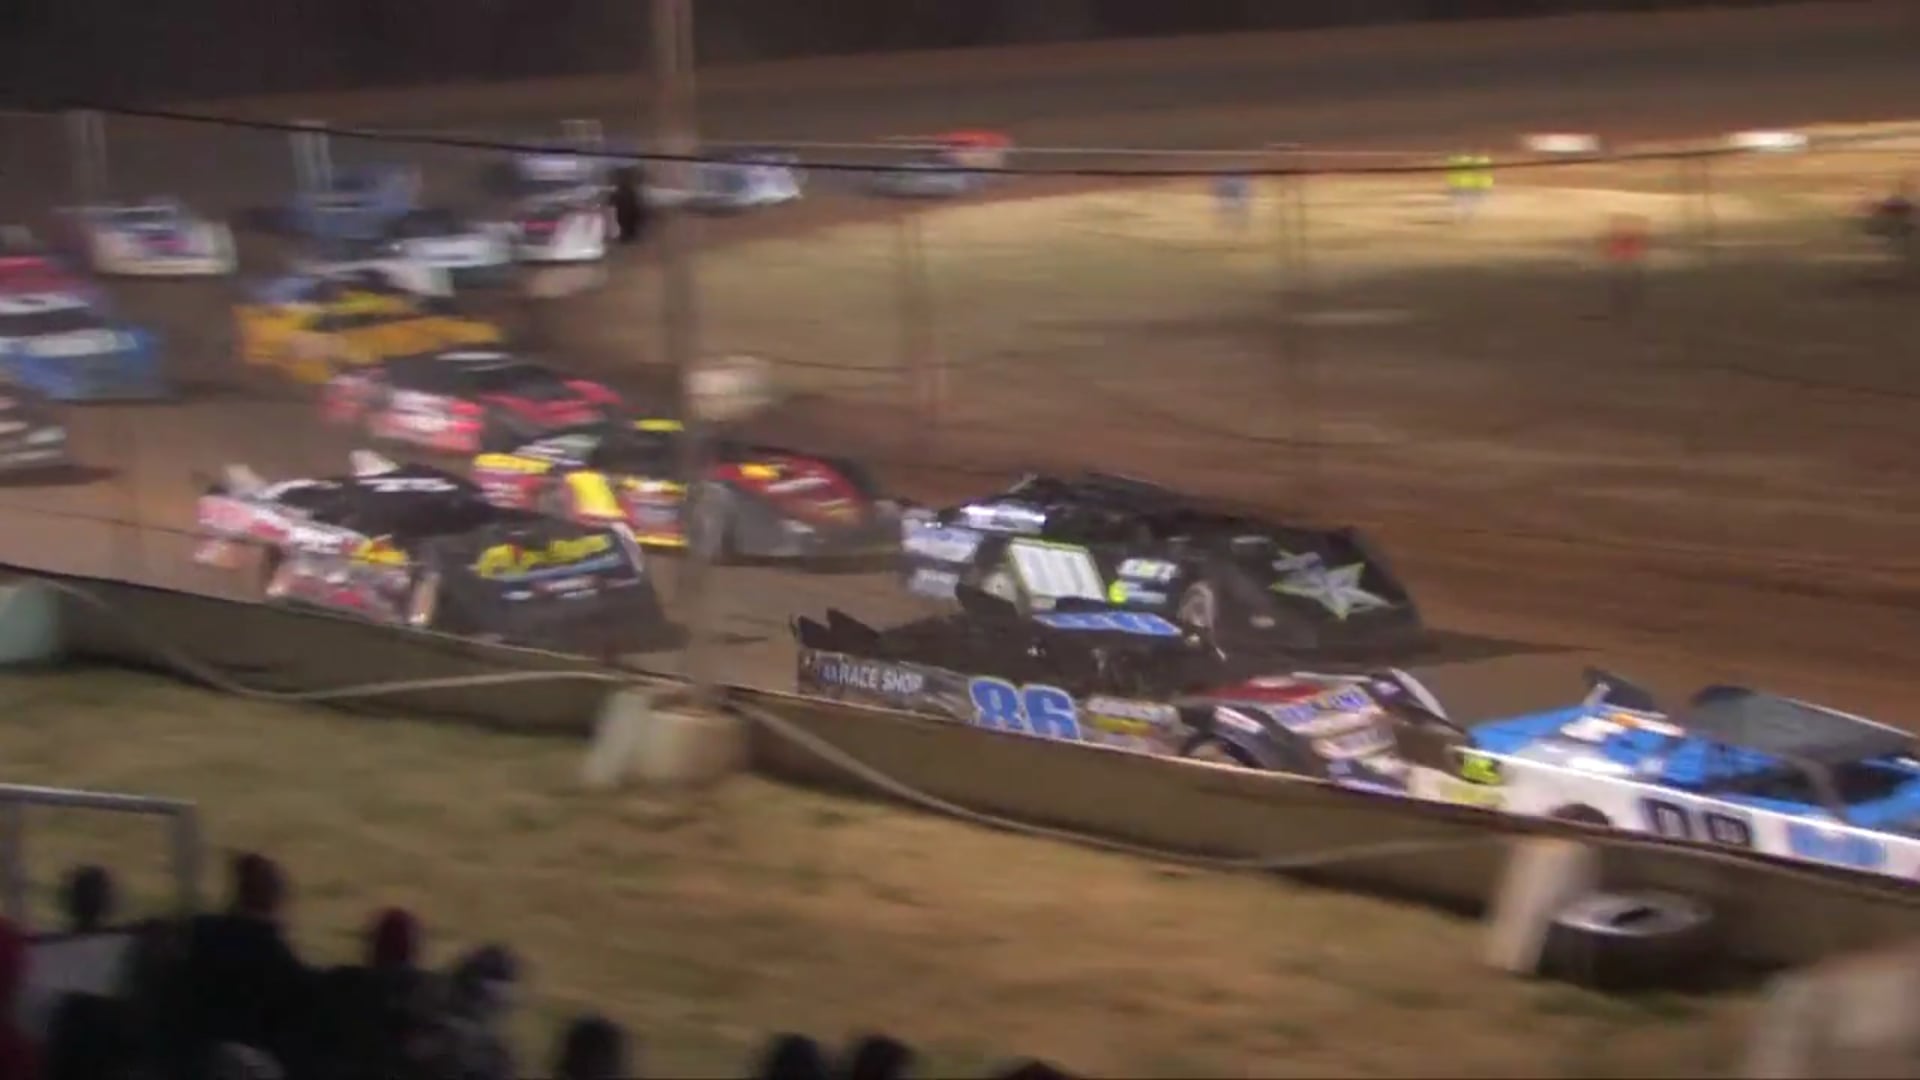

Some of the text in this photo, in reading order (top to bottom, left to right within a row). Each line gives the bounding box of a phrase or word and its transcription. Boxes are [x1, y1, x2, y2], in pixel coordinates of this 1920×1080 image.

[840, 663, 878, 689] RACE
[881, 669, 923, 693] SHOP
[968, 674, 1080, 741] 86
